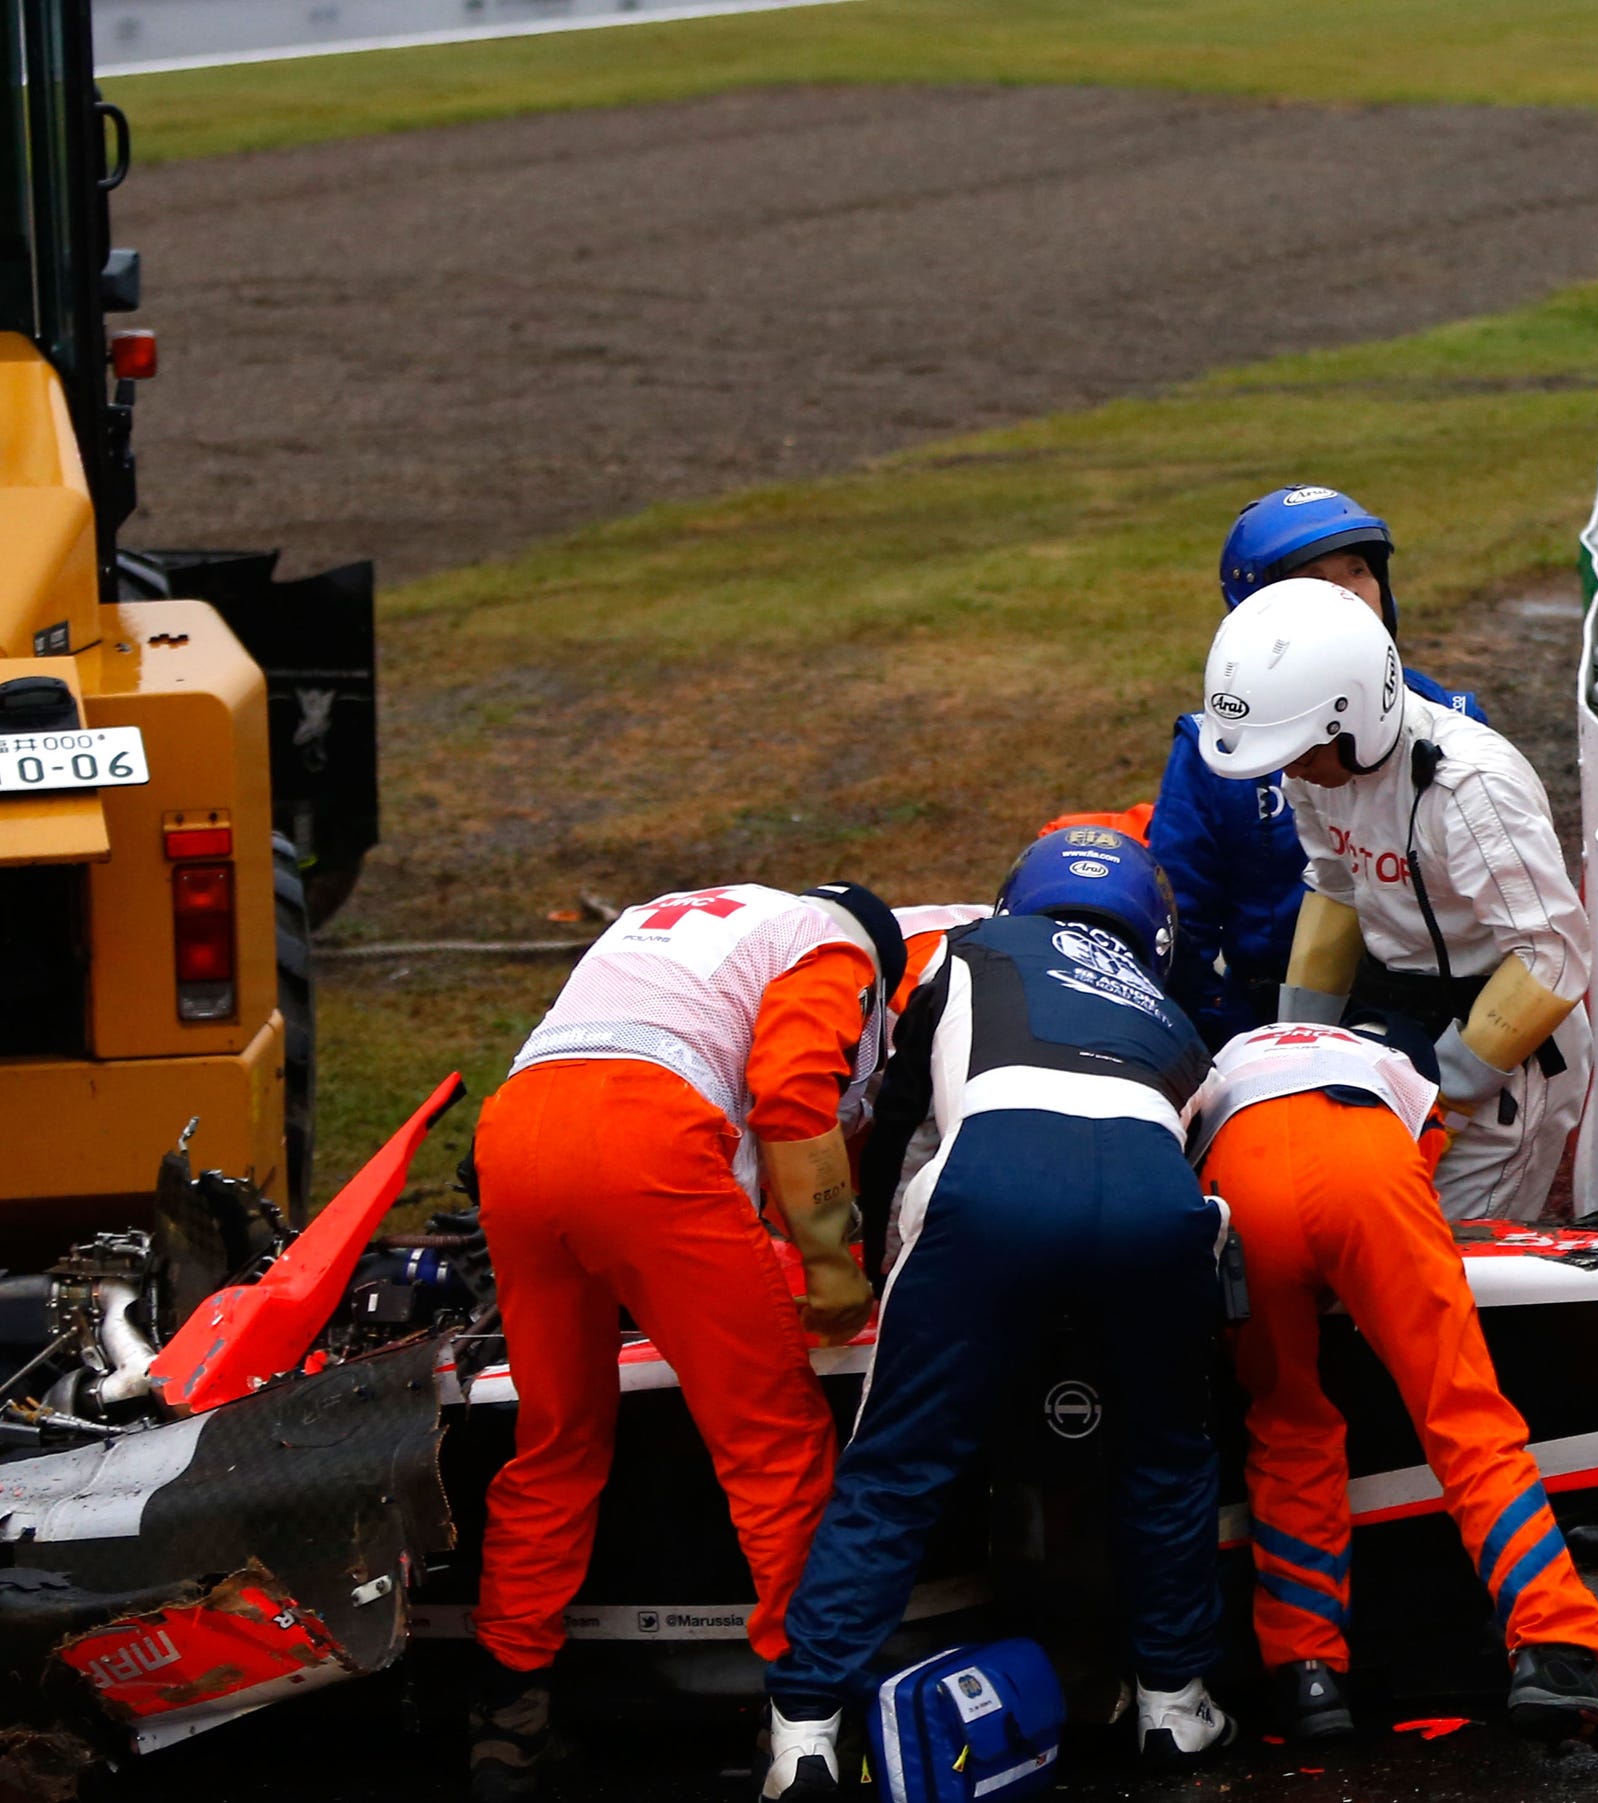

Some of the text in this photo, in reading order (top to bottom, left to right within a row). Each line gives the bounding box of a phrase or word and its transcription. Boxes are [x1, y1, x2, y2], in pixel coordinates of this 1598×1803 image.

[1213, 696, 1244, 713] Arai
[43, 735, 93, 750] 000
[0, 751, 134, 784] 0-06
[1070, 831, 1115, 847] FIA
[1062, 850, 1121, 864] www.fia.com
